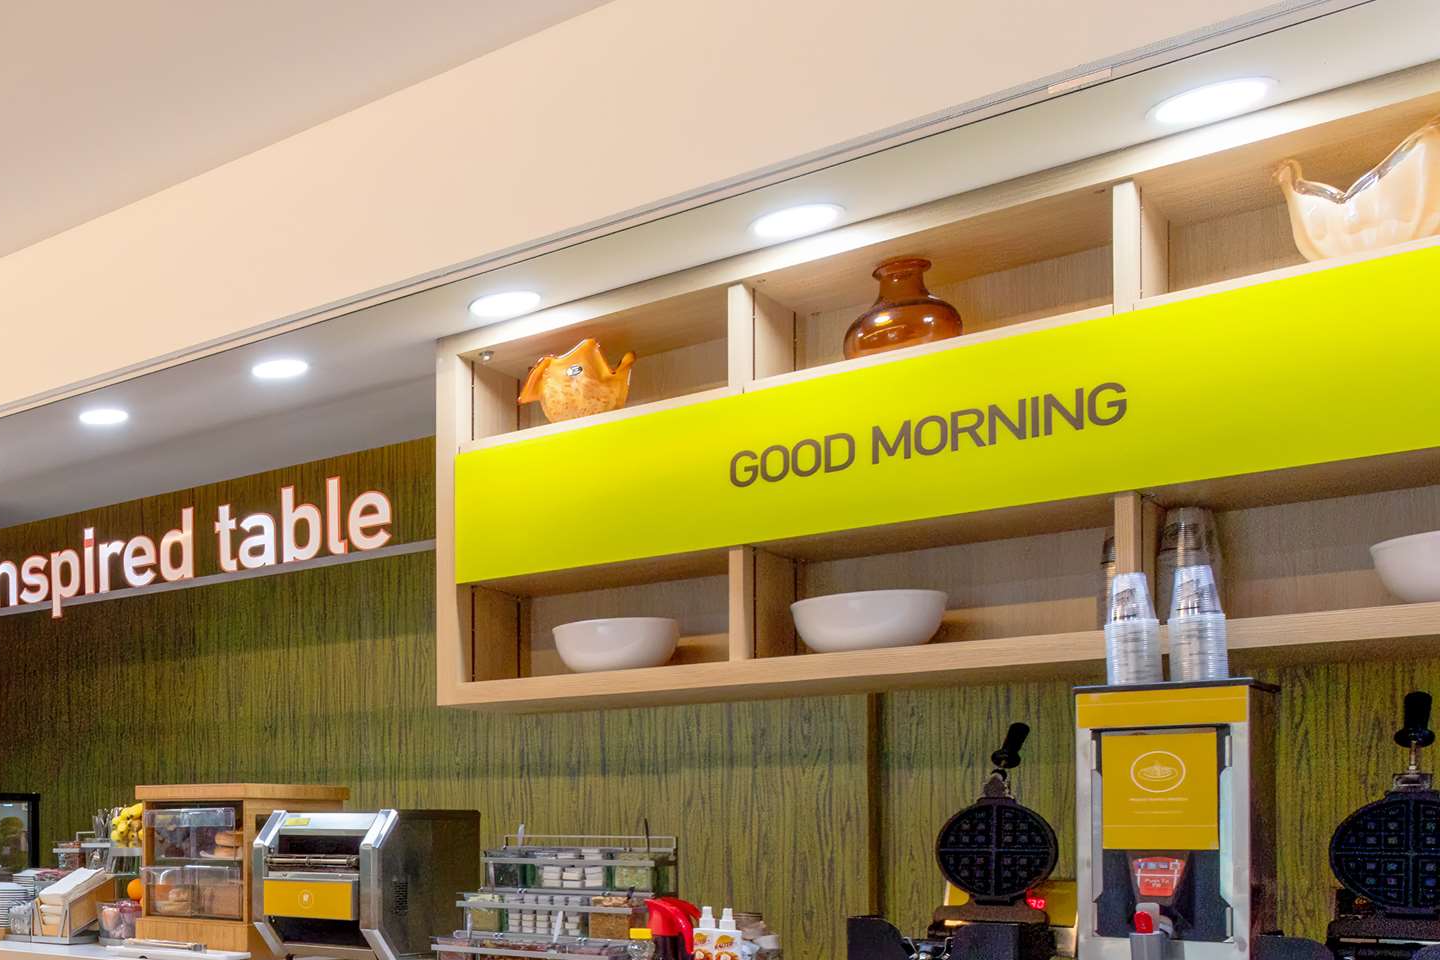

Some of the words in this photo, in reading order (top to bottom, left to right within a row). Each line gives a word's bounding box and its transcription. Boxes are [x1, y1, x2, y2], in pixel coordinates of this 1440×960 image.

[730, 432, 855, 488] GOOD
[871, 382, 1128, 465] MORNING
[214, 475, 393, 576] table
